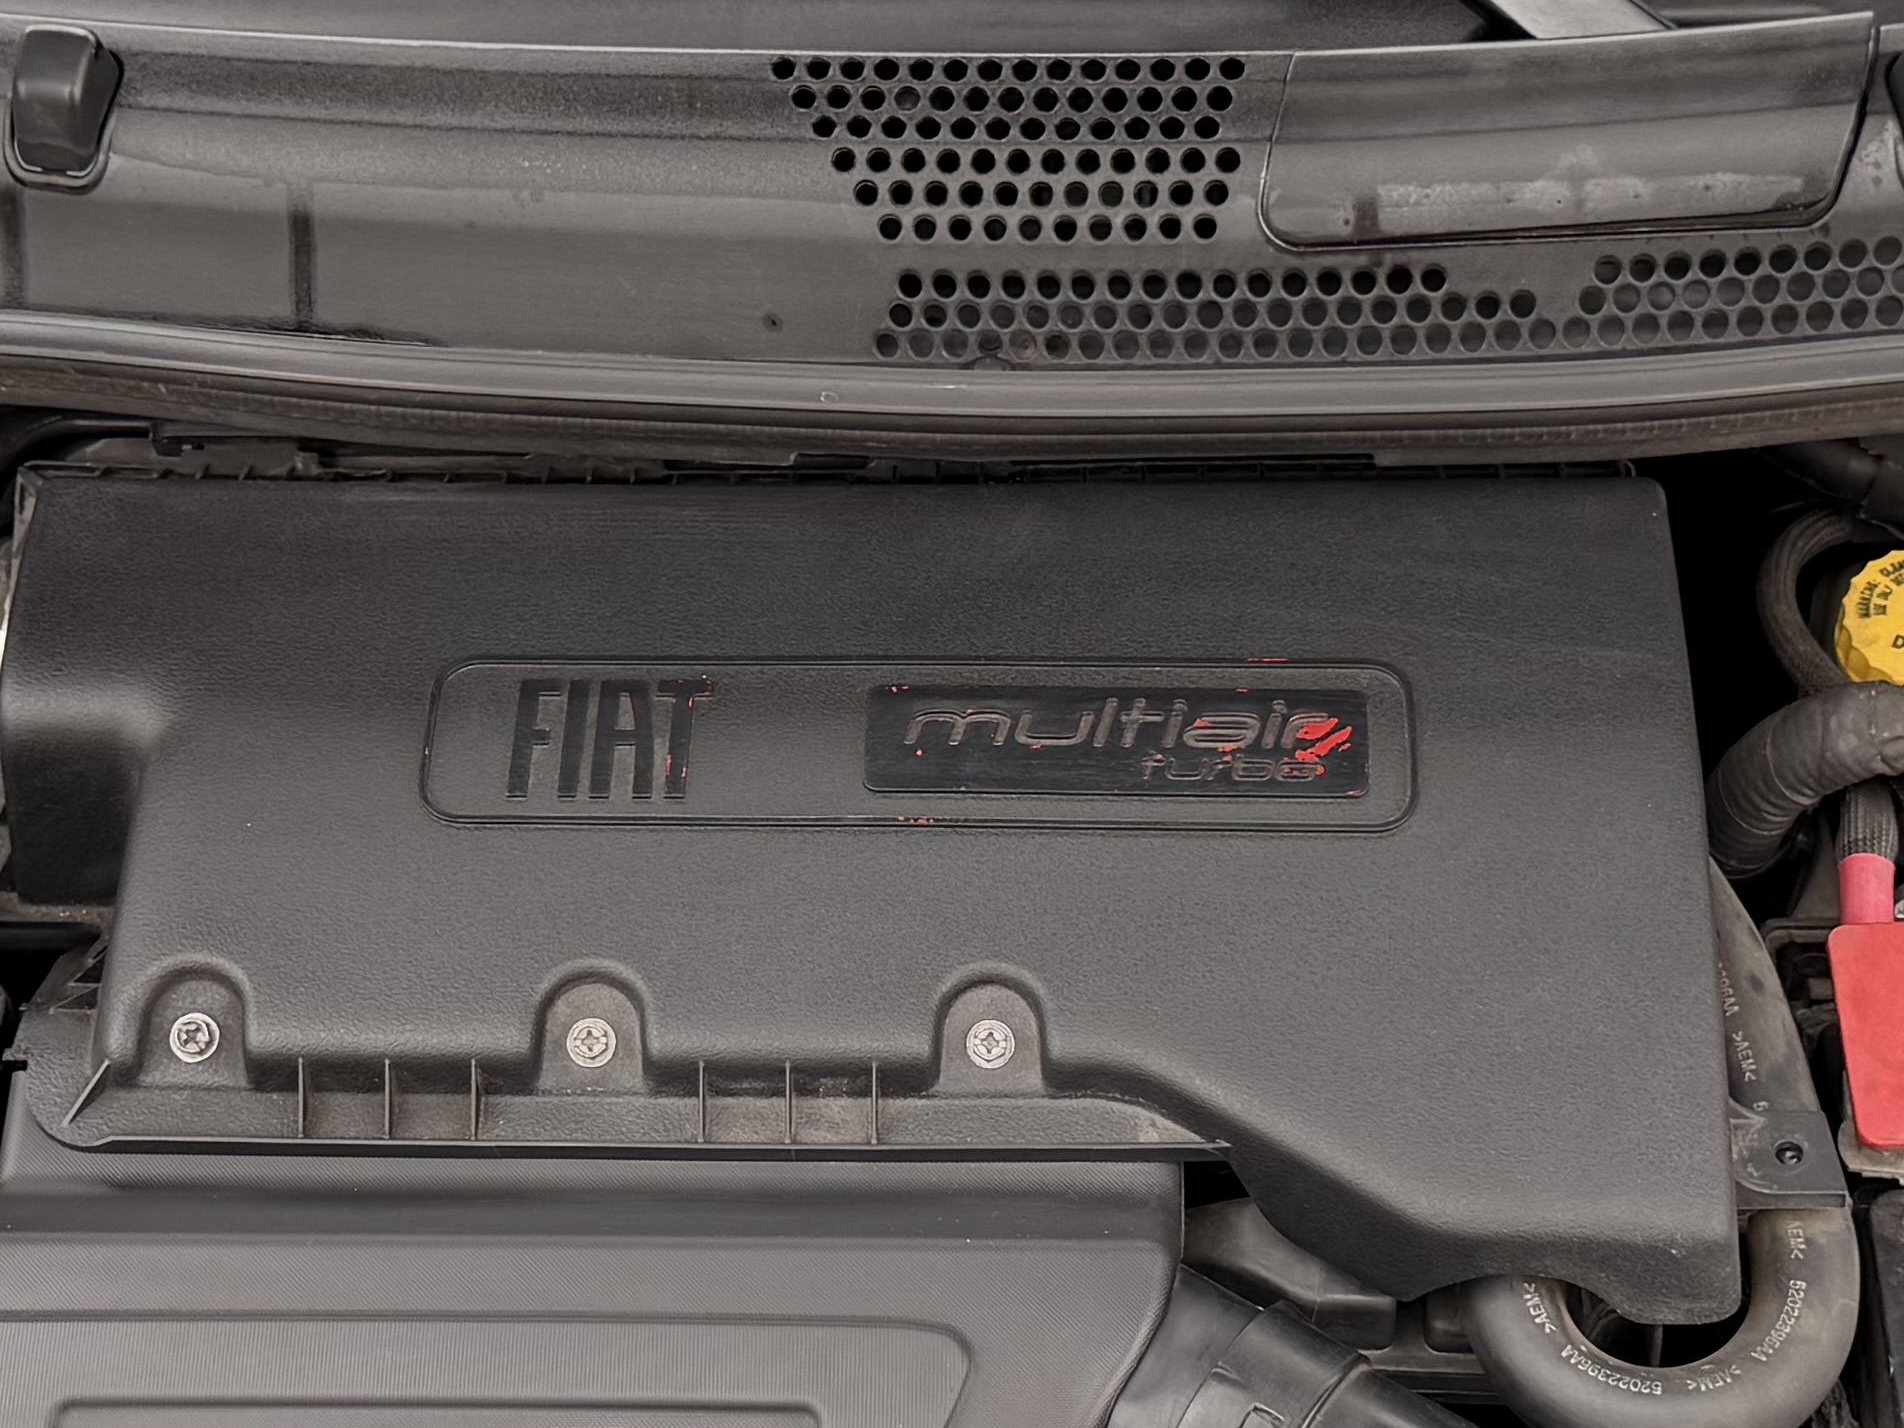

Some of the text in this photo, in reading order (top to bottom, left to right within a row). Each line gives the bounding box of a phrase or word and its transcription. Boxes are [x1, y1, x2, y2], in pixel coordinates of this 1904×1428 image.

[504, 675, 715, 802] FIAT
[902, 697, 1336, 751] multiair
[1143, 752, 1329, 783] turbo
